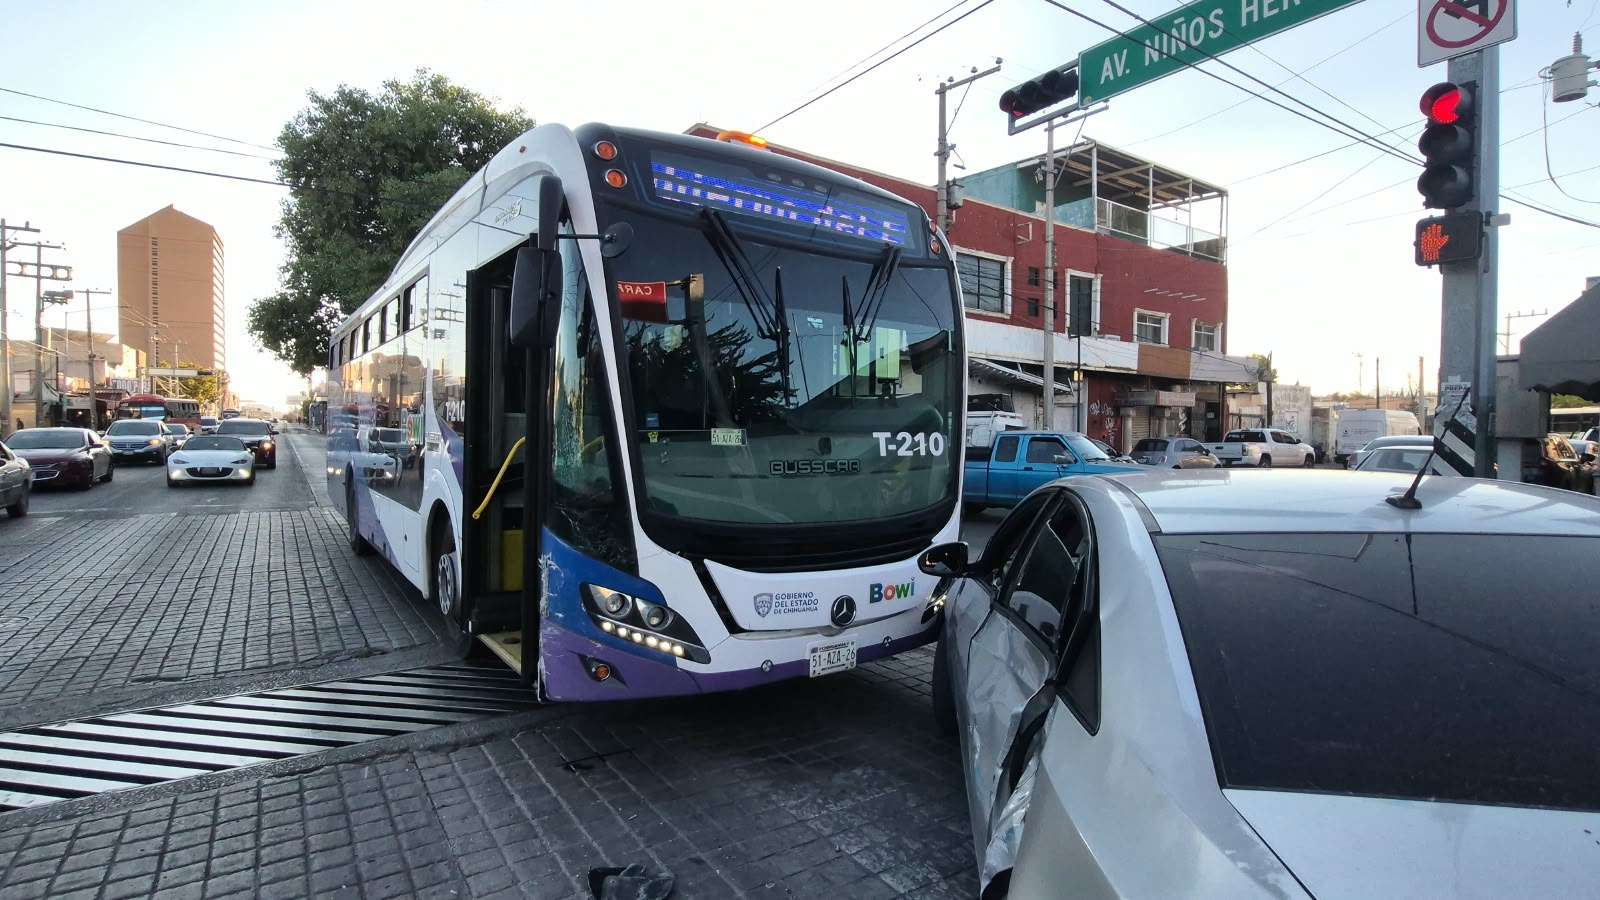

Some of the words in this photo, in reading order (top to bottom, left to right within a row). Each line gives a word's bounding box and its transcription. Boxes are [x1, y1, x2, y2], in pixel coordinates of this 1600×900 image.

[1100, 49, 1130, 84] AV.
[1144, 8, 1224, 66] NIÑOS
[872, 431, 945, 457] T-210
[770, 459, 861, 475] BUSSCAR
[775, 592, 814, 600] GOBIERNO
[790, 598, 819, 607] ESTADO
[783, 606, 818, 614] CHIHUAHUA
[812, 648, 856, 668] 51-AZA-26
